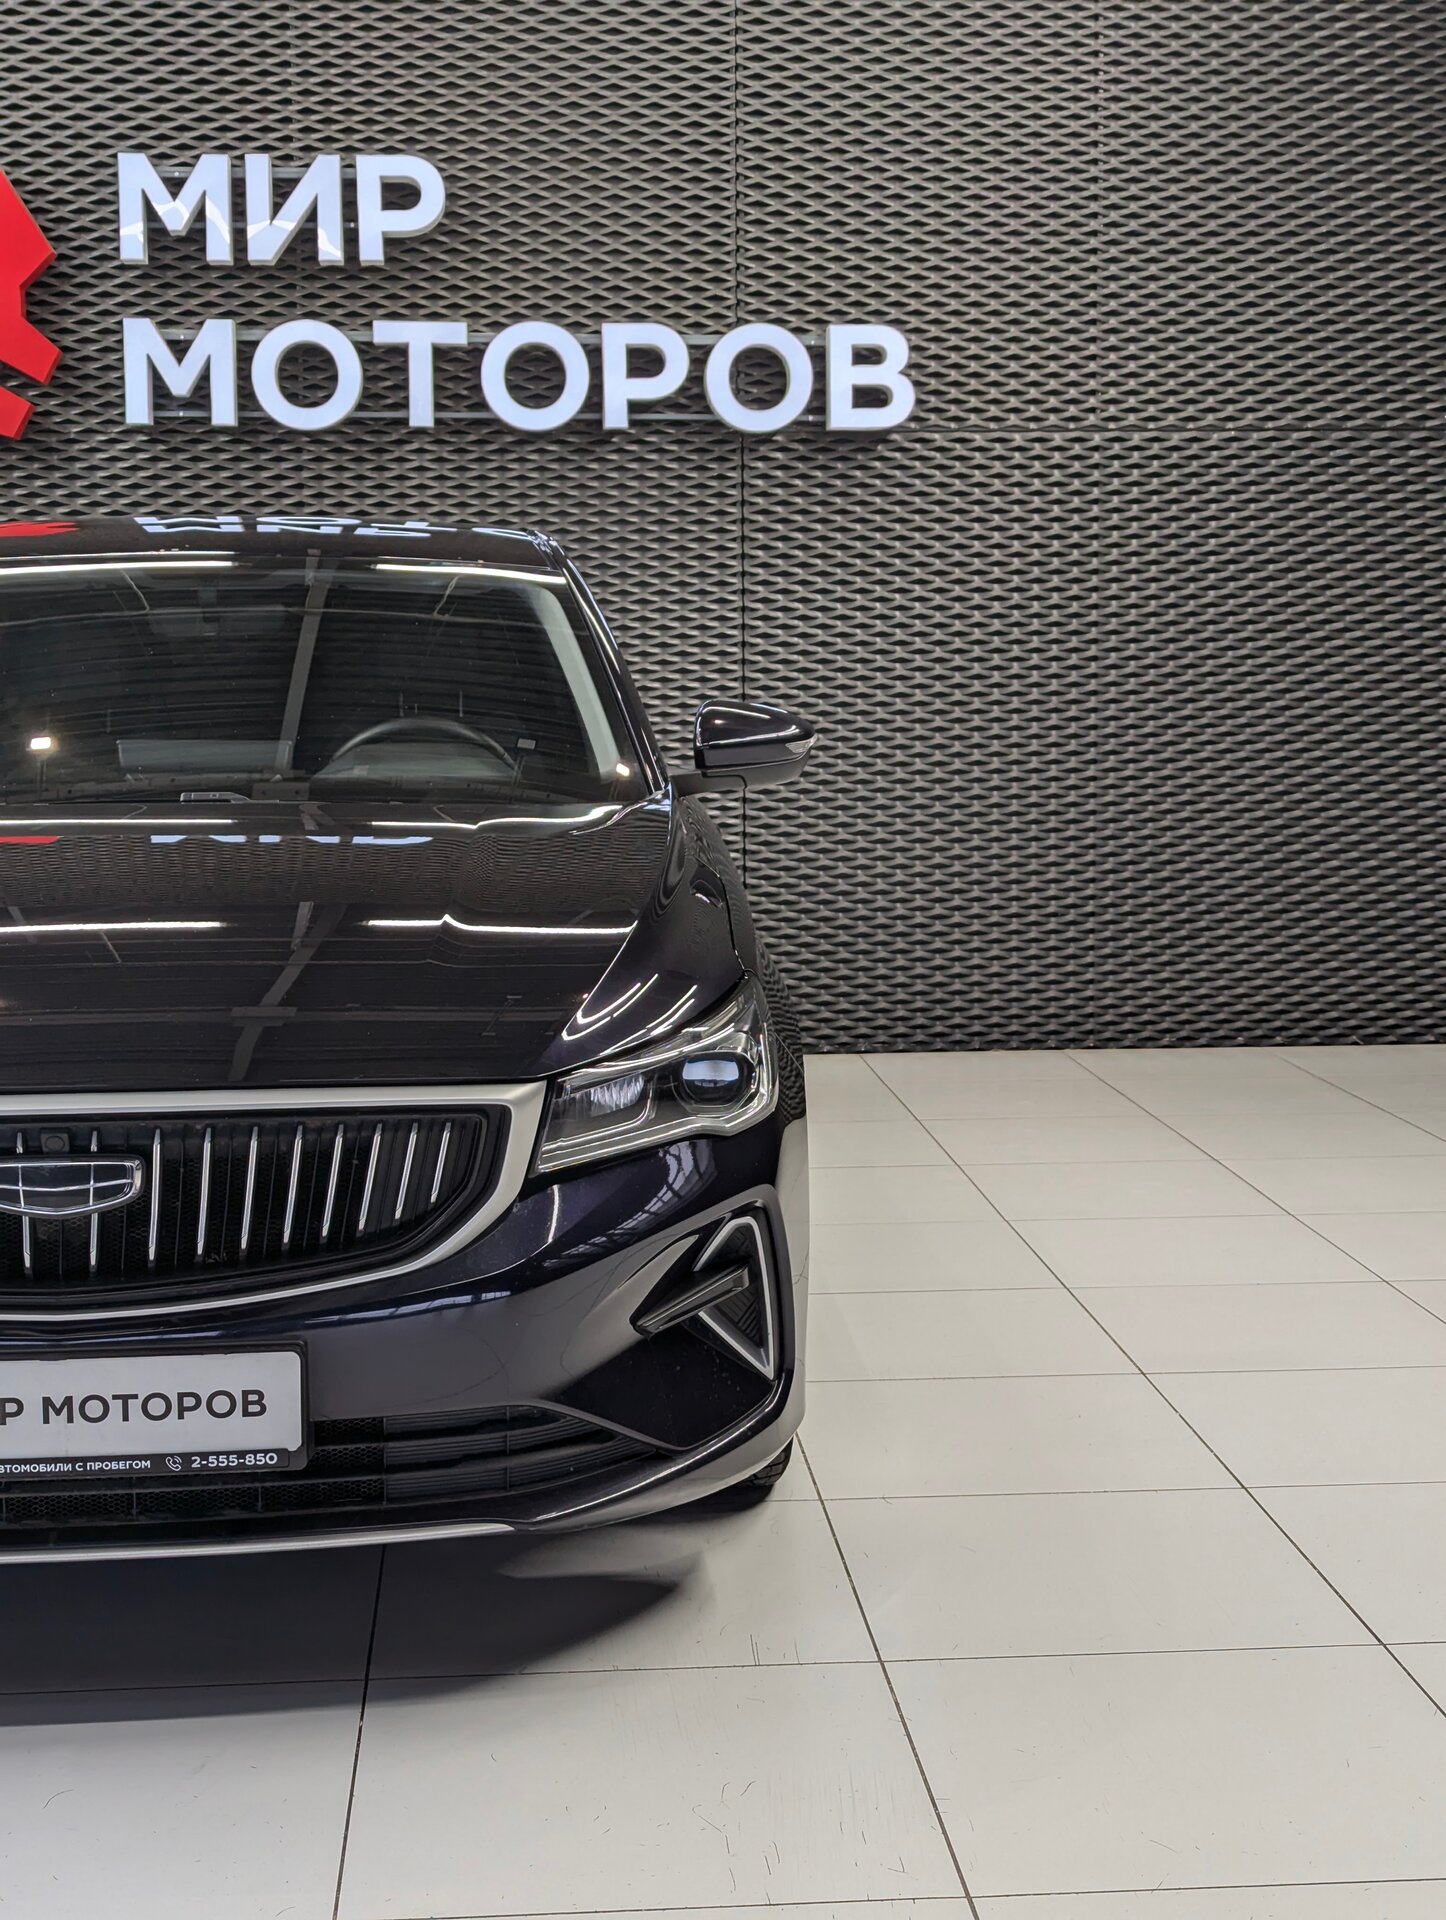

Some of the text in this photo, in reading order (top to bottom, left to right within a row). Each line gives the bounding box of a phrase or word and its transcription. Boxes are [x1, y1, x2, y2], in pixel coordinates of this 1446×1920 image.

[117, 151, 446, 266] МИР
[121, 317, 917, 435] МОТОРОВ
[42, 1389, 268, 1425] МОТОРОВ
[75, 1462, 84, 1471] С
[86, 1460, 151, 1471] ПРОБЕГОМ
[191, 1452, 278, 1468] 2-555-850
